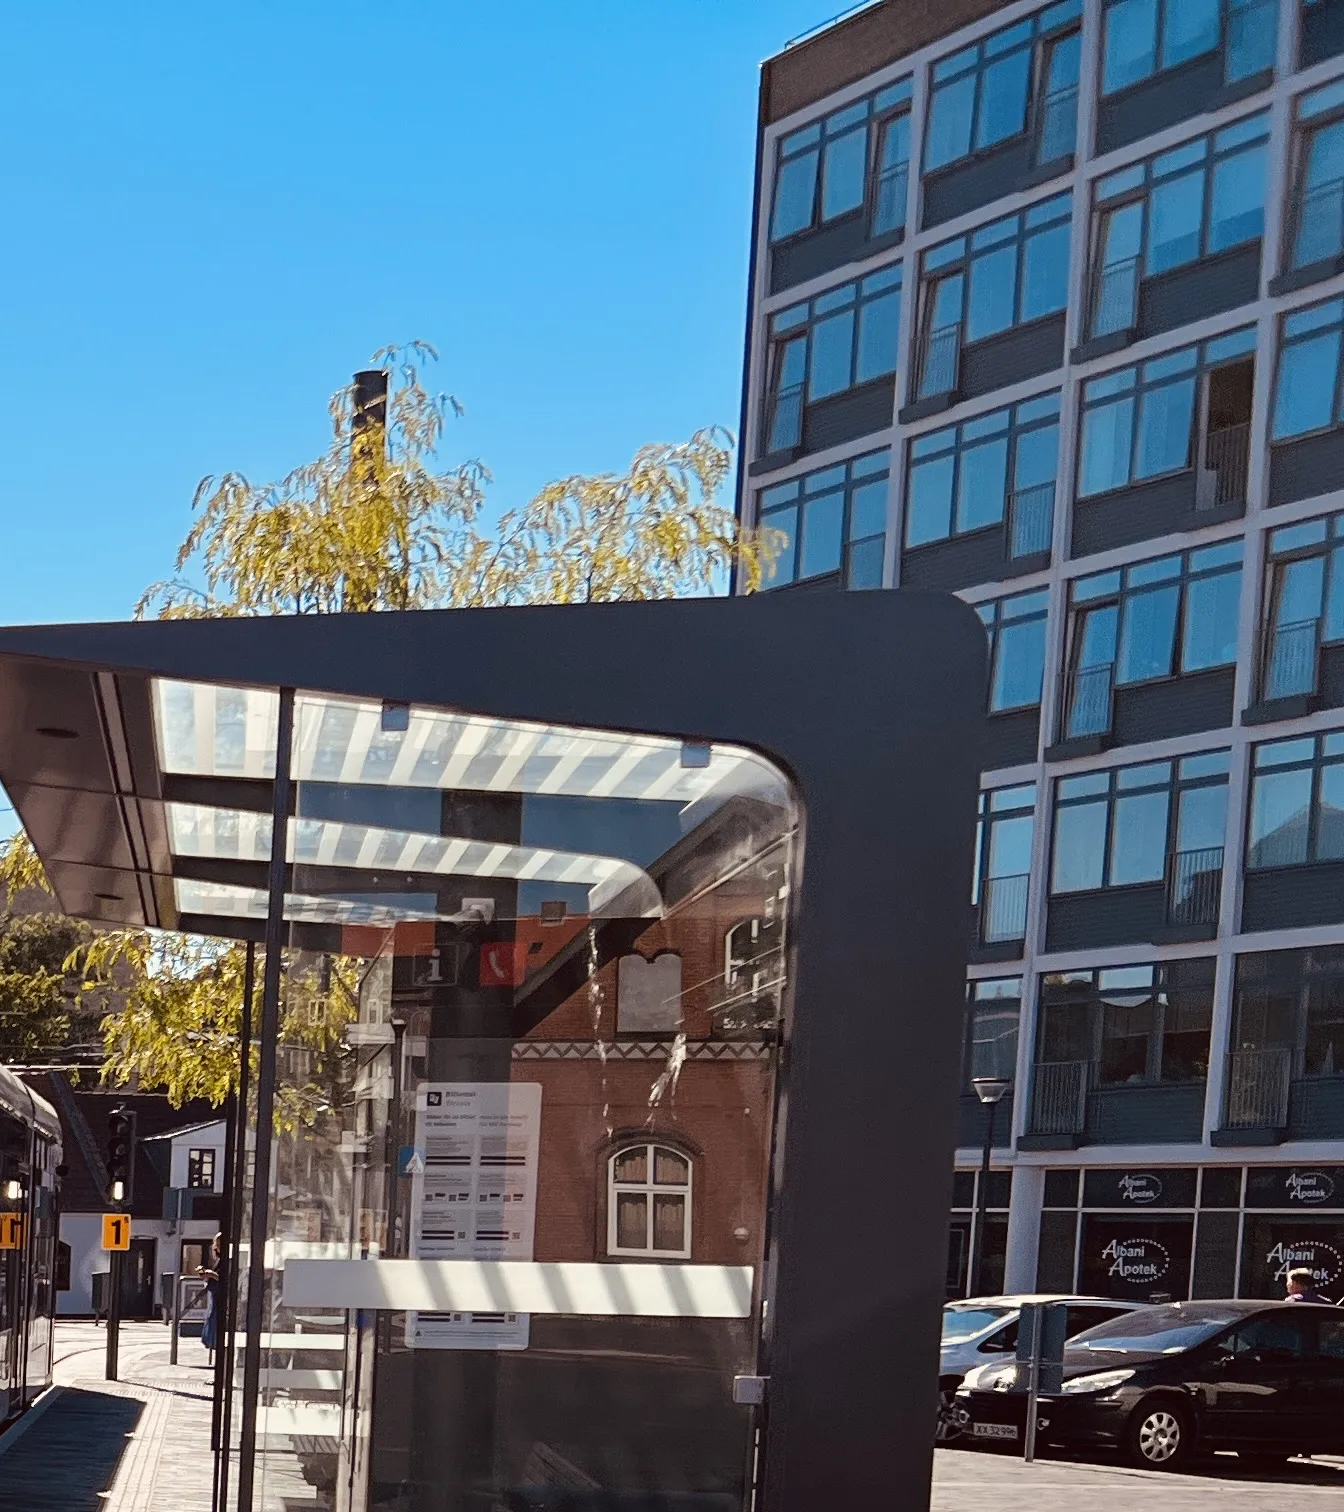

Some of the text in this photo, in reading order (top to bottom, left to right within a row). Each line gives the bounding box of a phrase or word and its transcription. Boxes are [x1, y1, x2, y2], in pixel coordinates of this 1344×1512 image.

[1118, 1175, 1147, 1187] Albani
[1286, 1173, 1317, 1187] Albani
[1123, 1187, 1155, 1200] Apotek
[1290, 1186, 1326, 1200] Apotek
[111, 1219, 122, 1246] 1
[1102, 1239, 1145, 1260] Albani
[1267, 1242, 1315, 1264] Albani
[1108, 1258, 1158, 1277] Apotek
[1274, 1263, 1329, 1282] Atek
